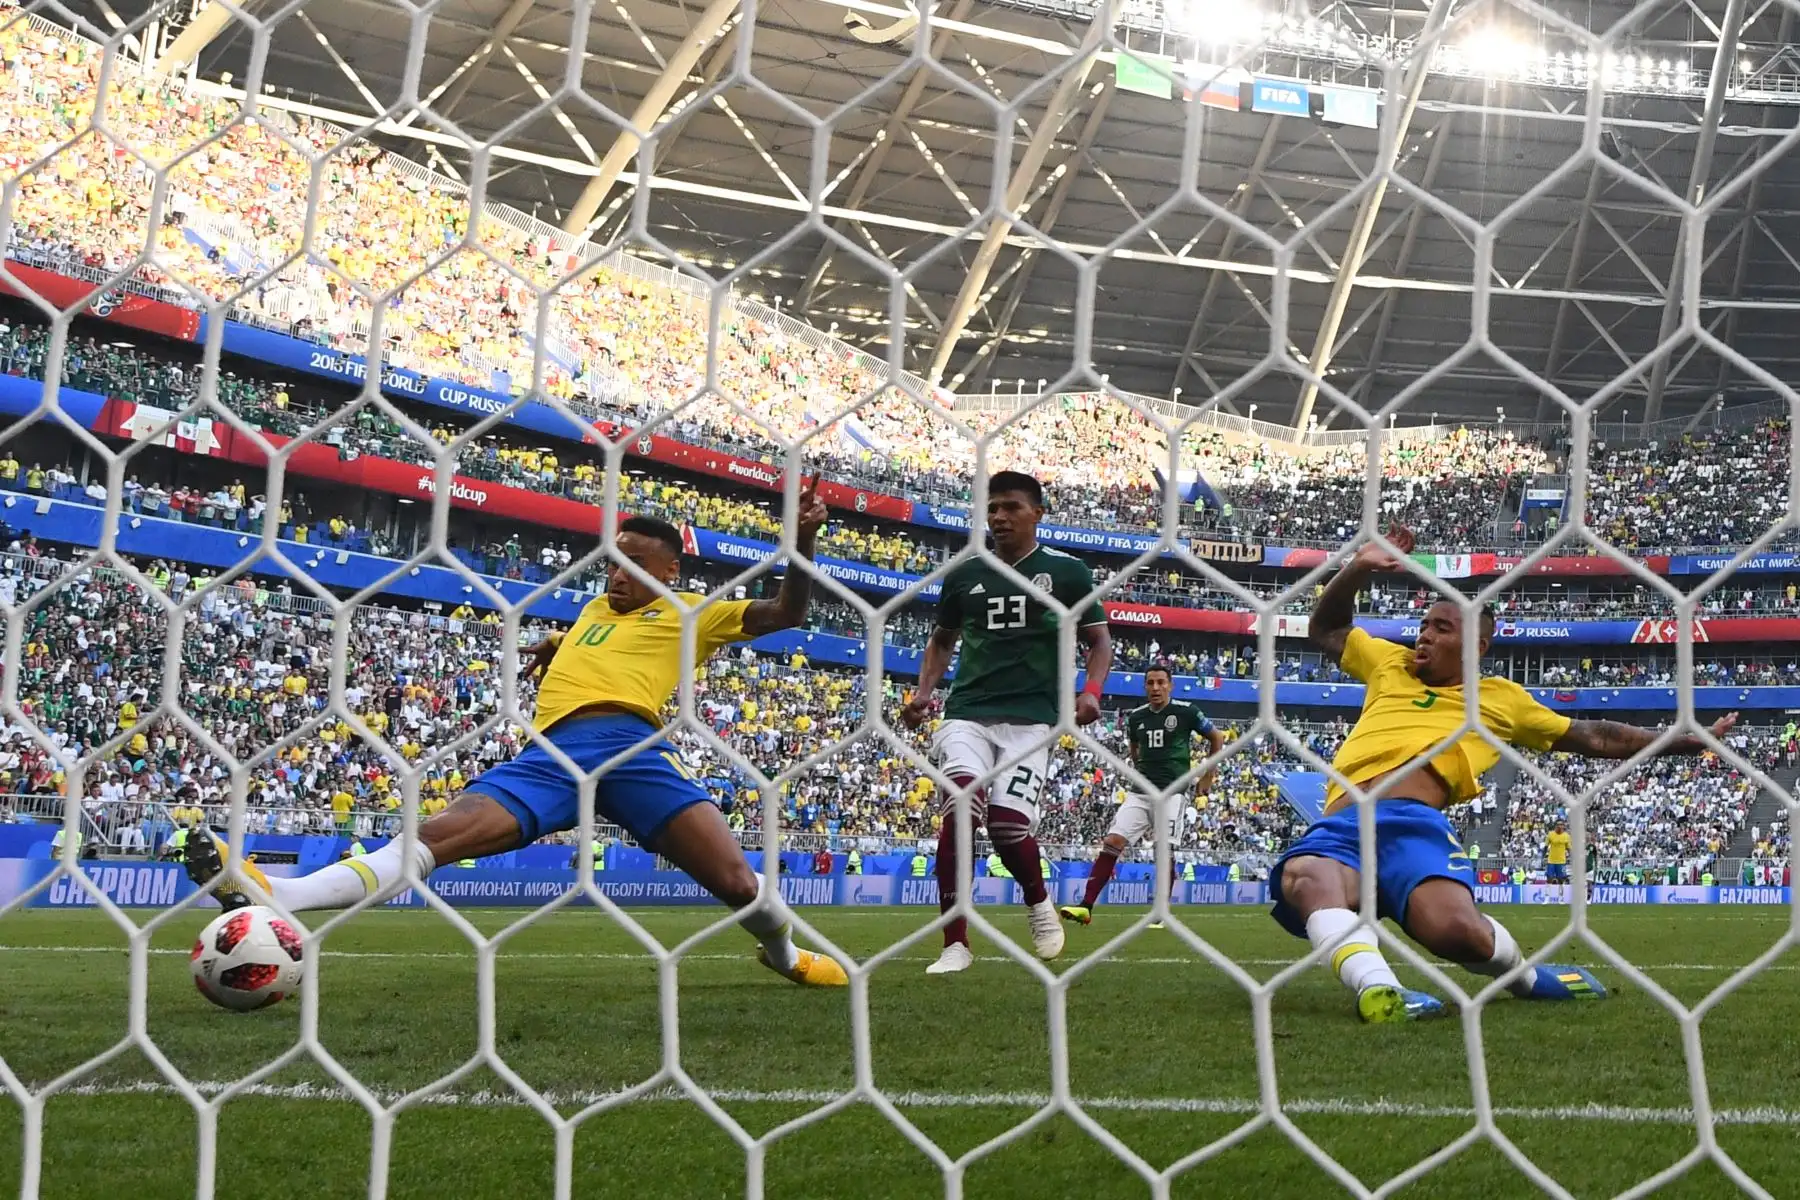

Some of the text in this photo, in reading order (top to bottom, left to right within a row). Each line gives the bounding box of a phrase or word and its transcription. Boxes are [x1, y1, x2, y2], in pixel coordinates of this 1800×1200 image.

[1260, 87, 1301, 105] FIFA
[345, 361, 369, 381] FIF
[379, 372, 425, 394] ORLD
[440, 387, 468, 405] CUP
[417, 475, 488, 506] #wrldcup
[1036, 527, 1052, 539] ПО
[1054, 530, 1105, 545] ФУТБОЛУ
[1108, 537, 1132, 550] FIFA
[860, 571, 877, 586] FIFA
[879, 575, 897, 589] 2018
[986, 595, 1027, 630] 23
[1110, 609, 1162, 625] САМАРА
[574, 623, 618, 647] 10
[1526, 627, 1569, 637] RUSSIA
[1146, 729, 1164, 748] 18
[1006, 765, 1043, 807] 23
[434, 880, 522, 897] ЧЕМПИОНАТ
[524, 881, 563, 897] МИРА
[597, 882, 645, 897] УТБОЛУ
[646, 883, 671, 897] FIFA
[673, 883, 698, 898] 2018
[778, 878, 834, 905] AZPROM
[1107, 884, 1148, 904] GAZPROM
[1593, 887, 1647, 904] AZPROM
[1719, 888, 1783, 905] GAZPROM
